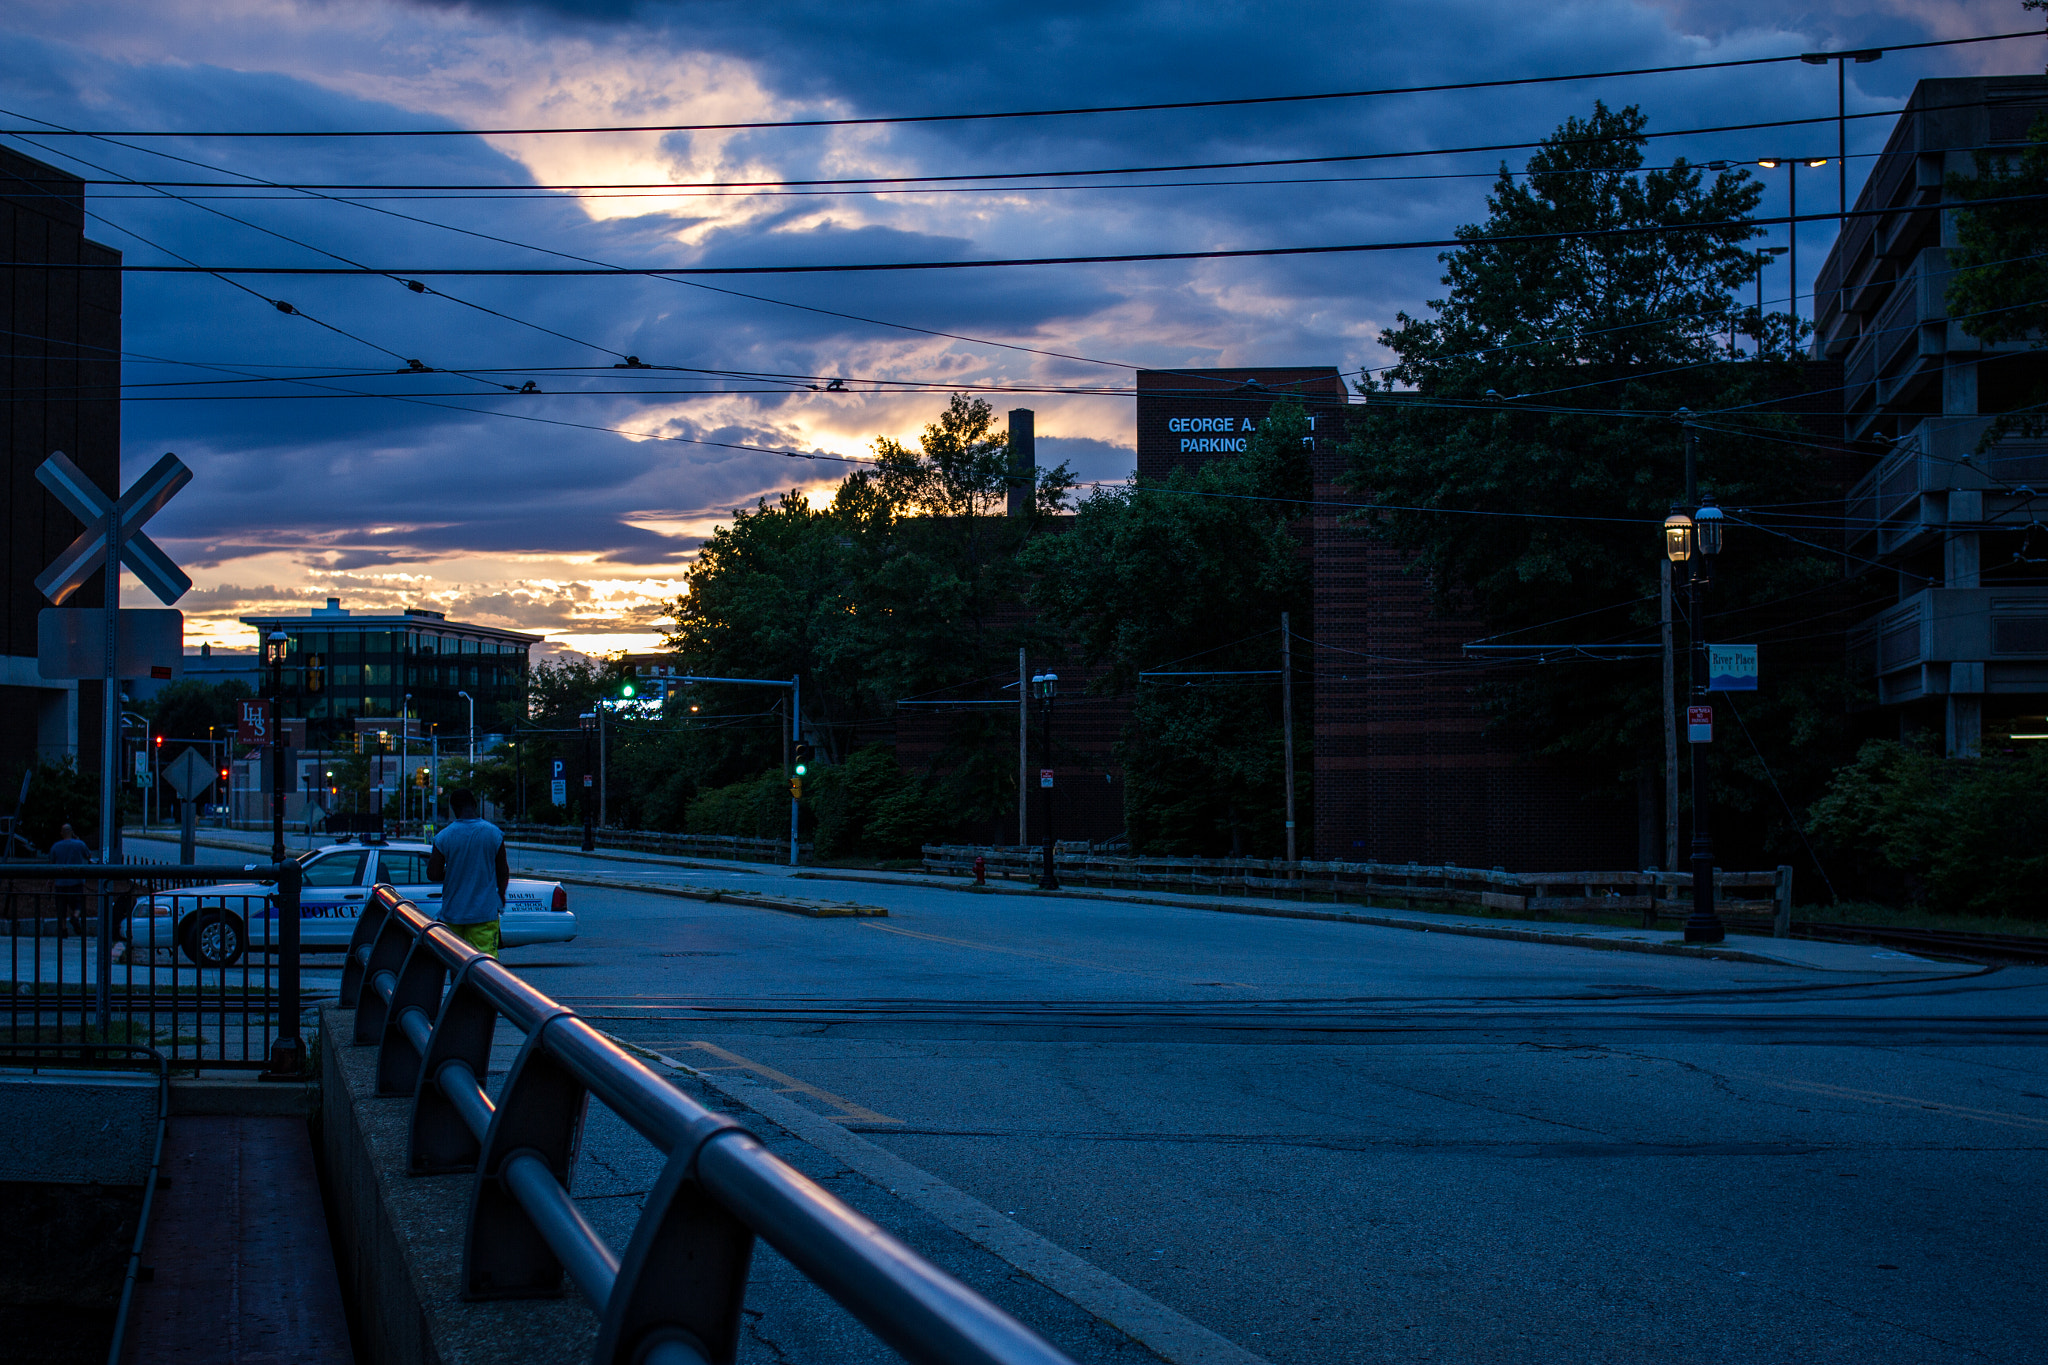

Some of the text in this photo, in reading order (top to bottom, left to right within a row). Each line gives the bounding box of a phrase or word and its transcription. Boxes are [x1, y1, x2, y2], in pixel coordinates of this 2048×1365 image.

[1168, 417, 1234, 432] GEORGE
[1241, 417, 1256, 432] A.
[1180, 438, 1247, 453] PARKING
[1712, 653, 1755, 664] River Place
[242, 702, 266, 737] LHS
[554, 760, 563, 778] P
[300, 906, 360, 918] POLICE
